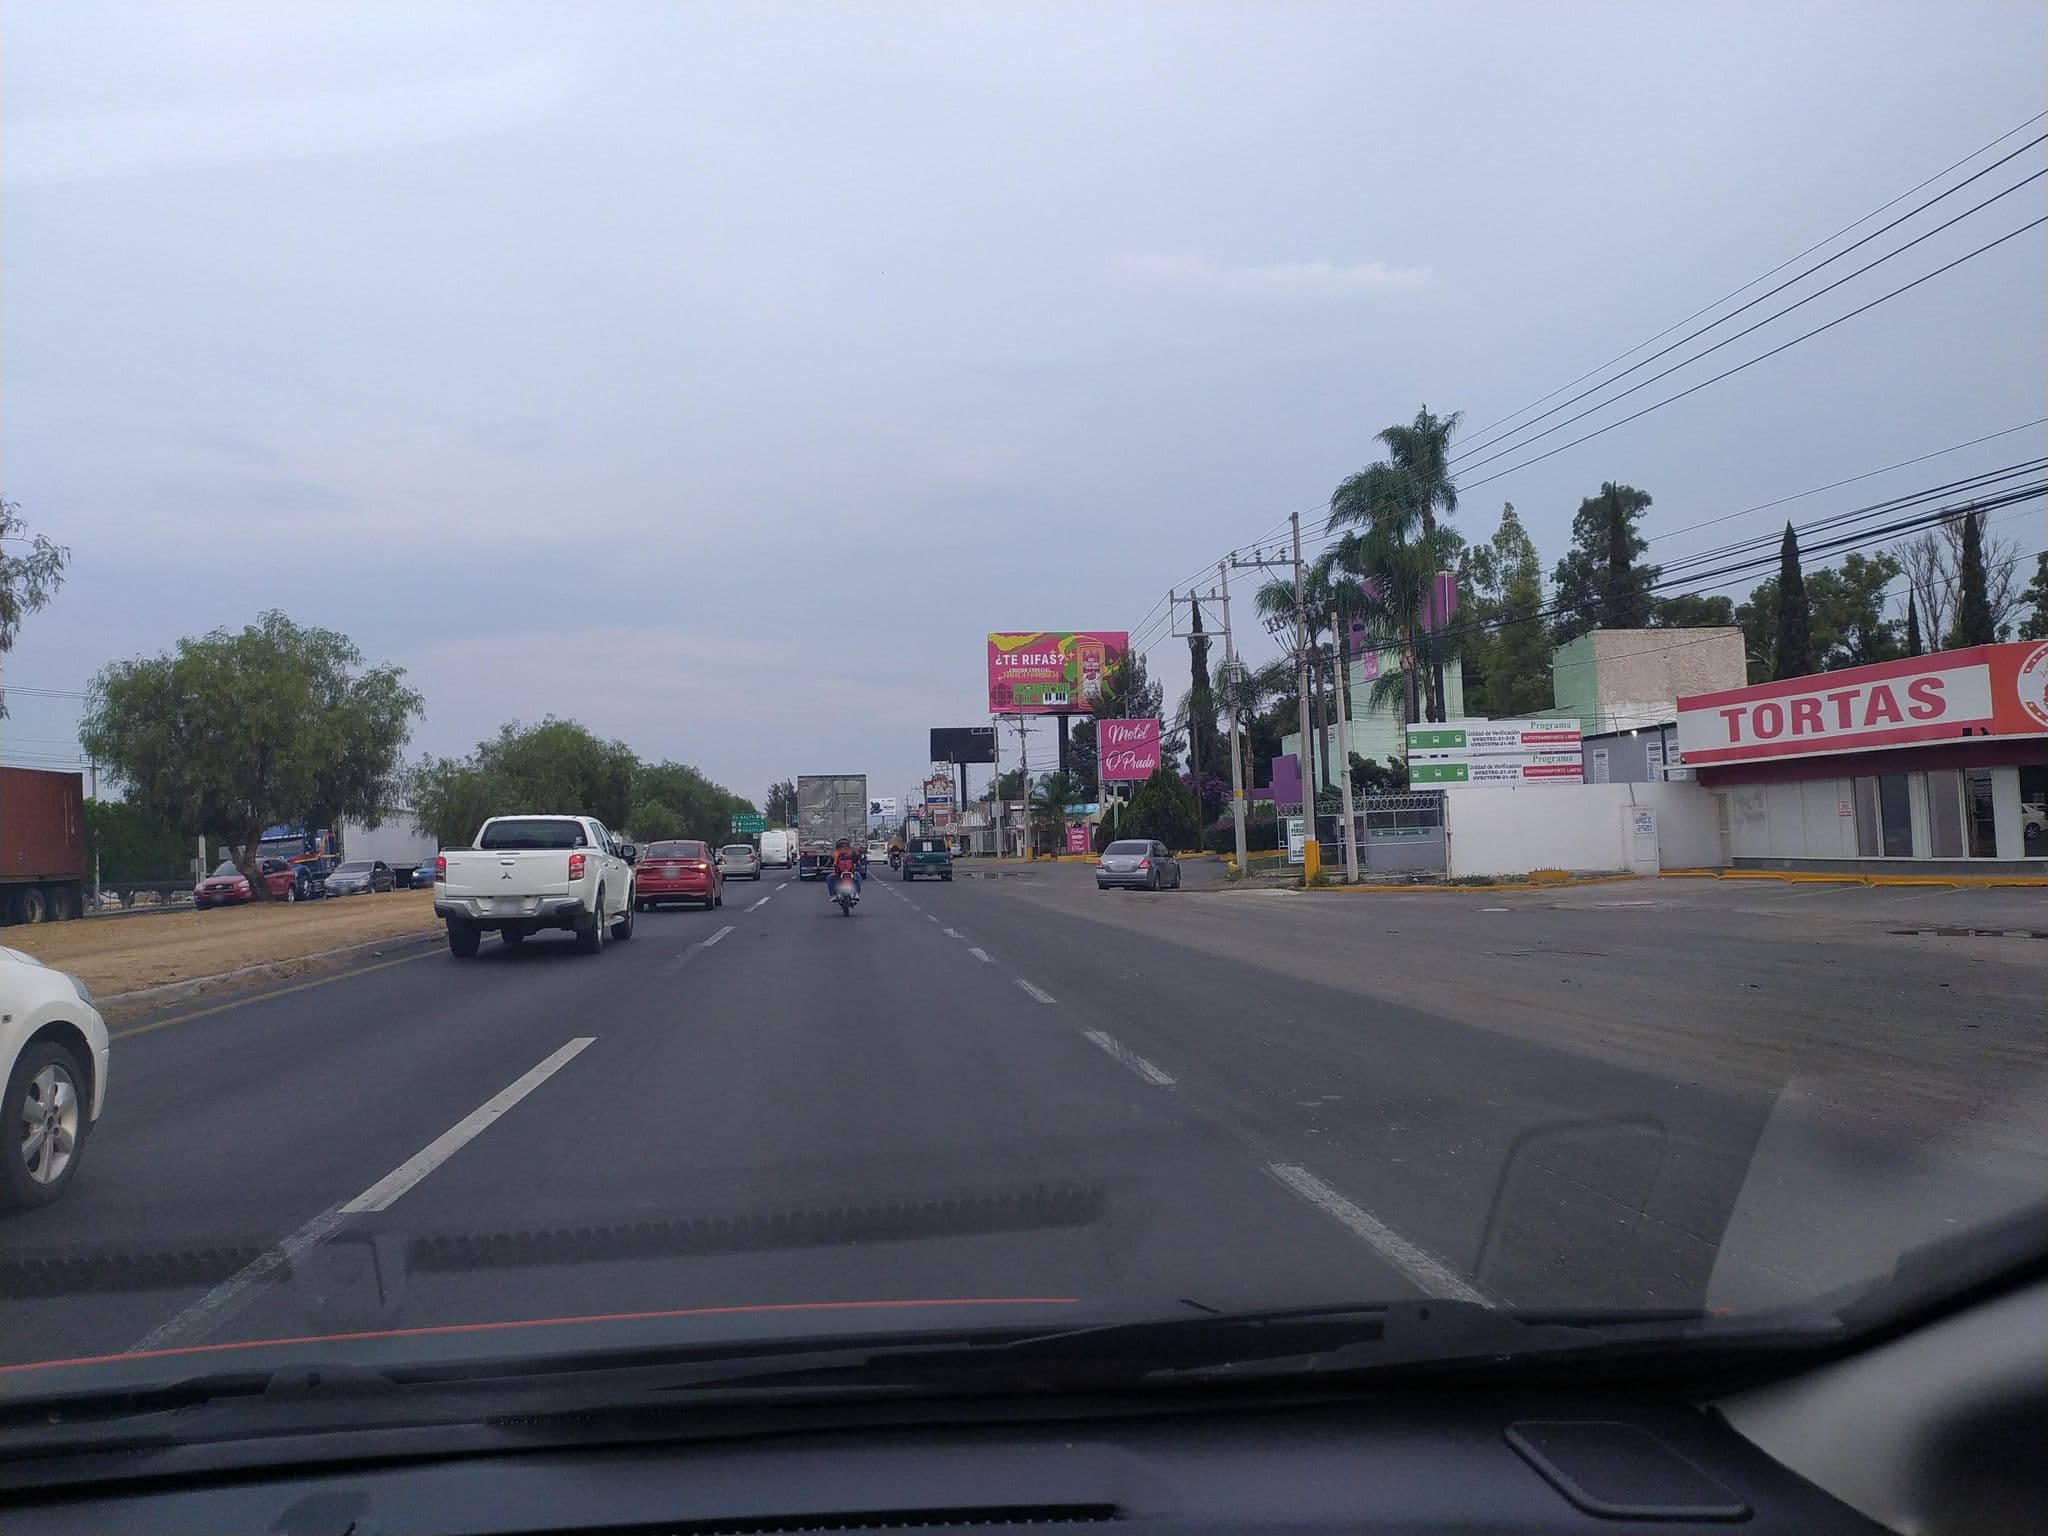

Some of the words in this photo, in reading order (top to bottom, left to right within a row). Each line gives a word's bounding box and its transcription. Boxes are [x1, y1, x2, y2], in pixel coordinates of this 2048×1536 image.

[995, 655, 1020, 665] ¿TE
[1022, 654, 1064, 665] RIFAS?
[1720, 677, 1947, 743] TORTAS
[1530, 721, 1572, 729] Programa
[1108, 723, 1151, 745] Motel
[1532, 755, 1573, 763] Programa
